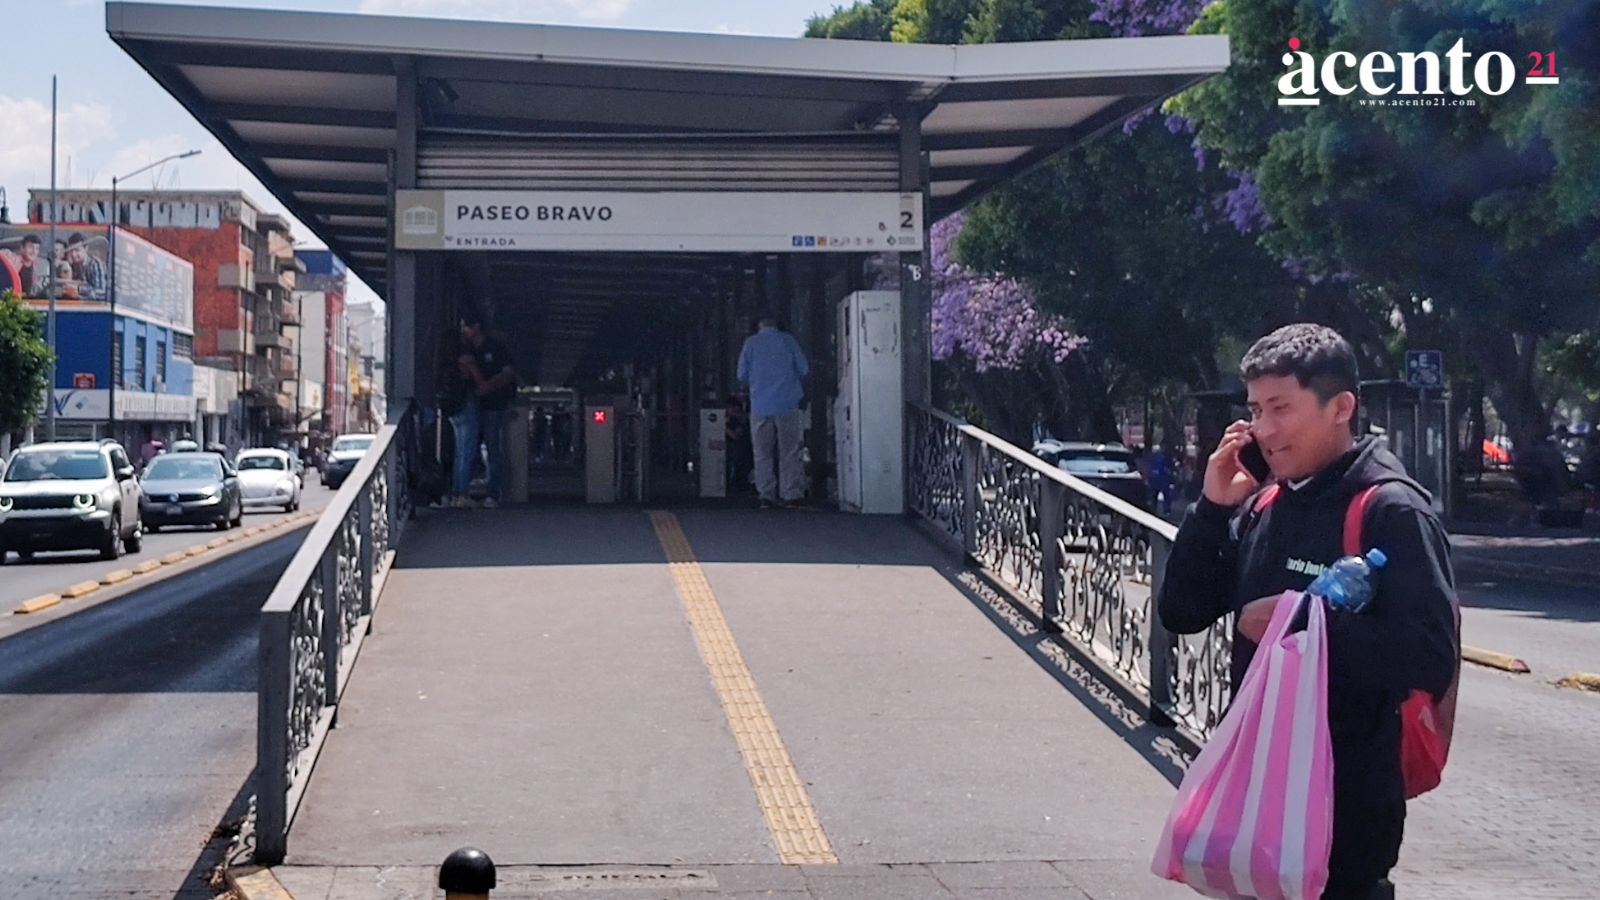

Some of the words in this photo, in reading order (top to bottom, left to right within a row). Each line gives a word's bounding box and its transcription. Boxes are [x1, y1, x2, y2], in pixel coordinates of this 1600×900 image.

[457, 205, 530, 221] PASEO
[537, 205, 613, 221] BRAVO
[900, 211, 913, 229] 2
[456, 237, 516, 247] ENTRADA
